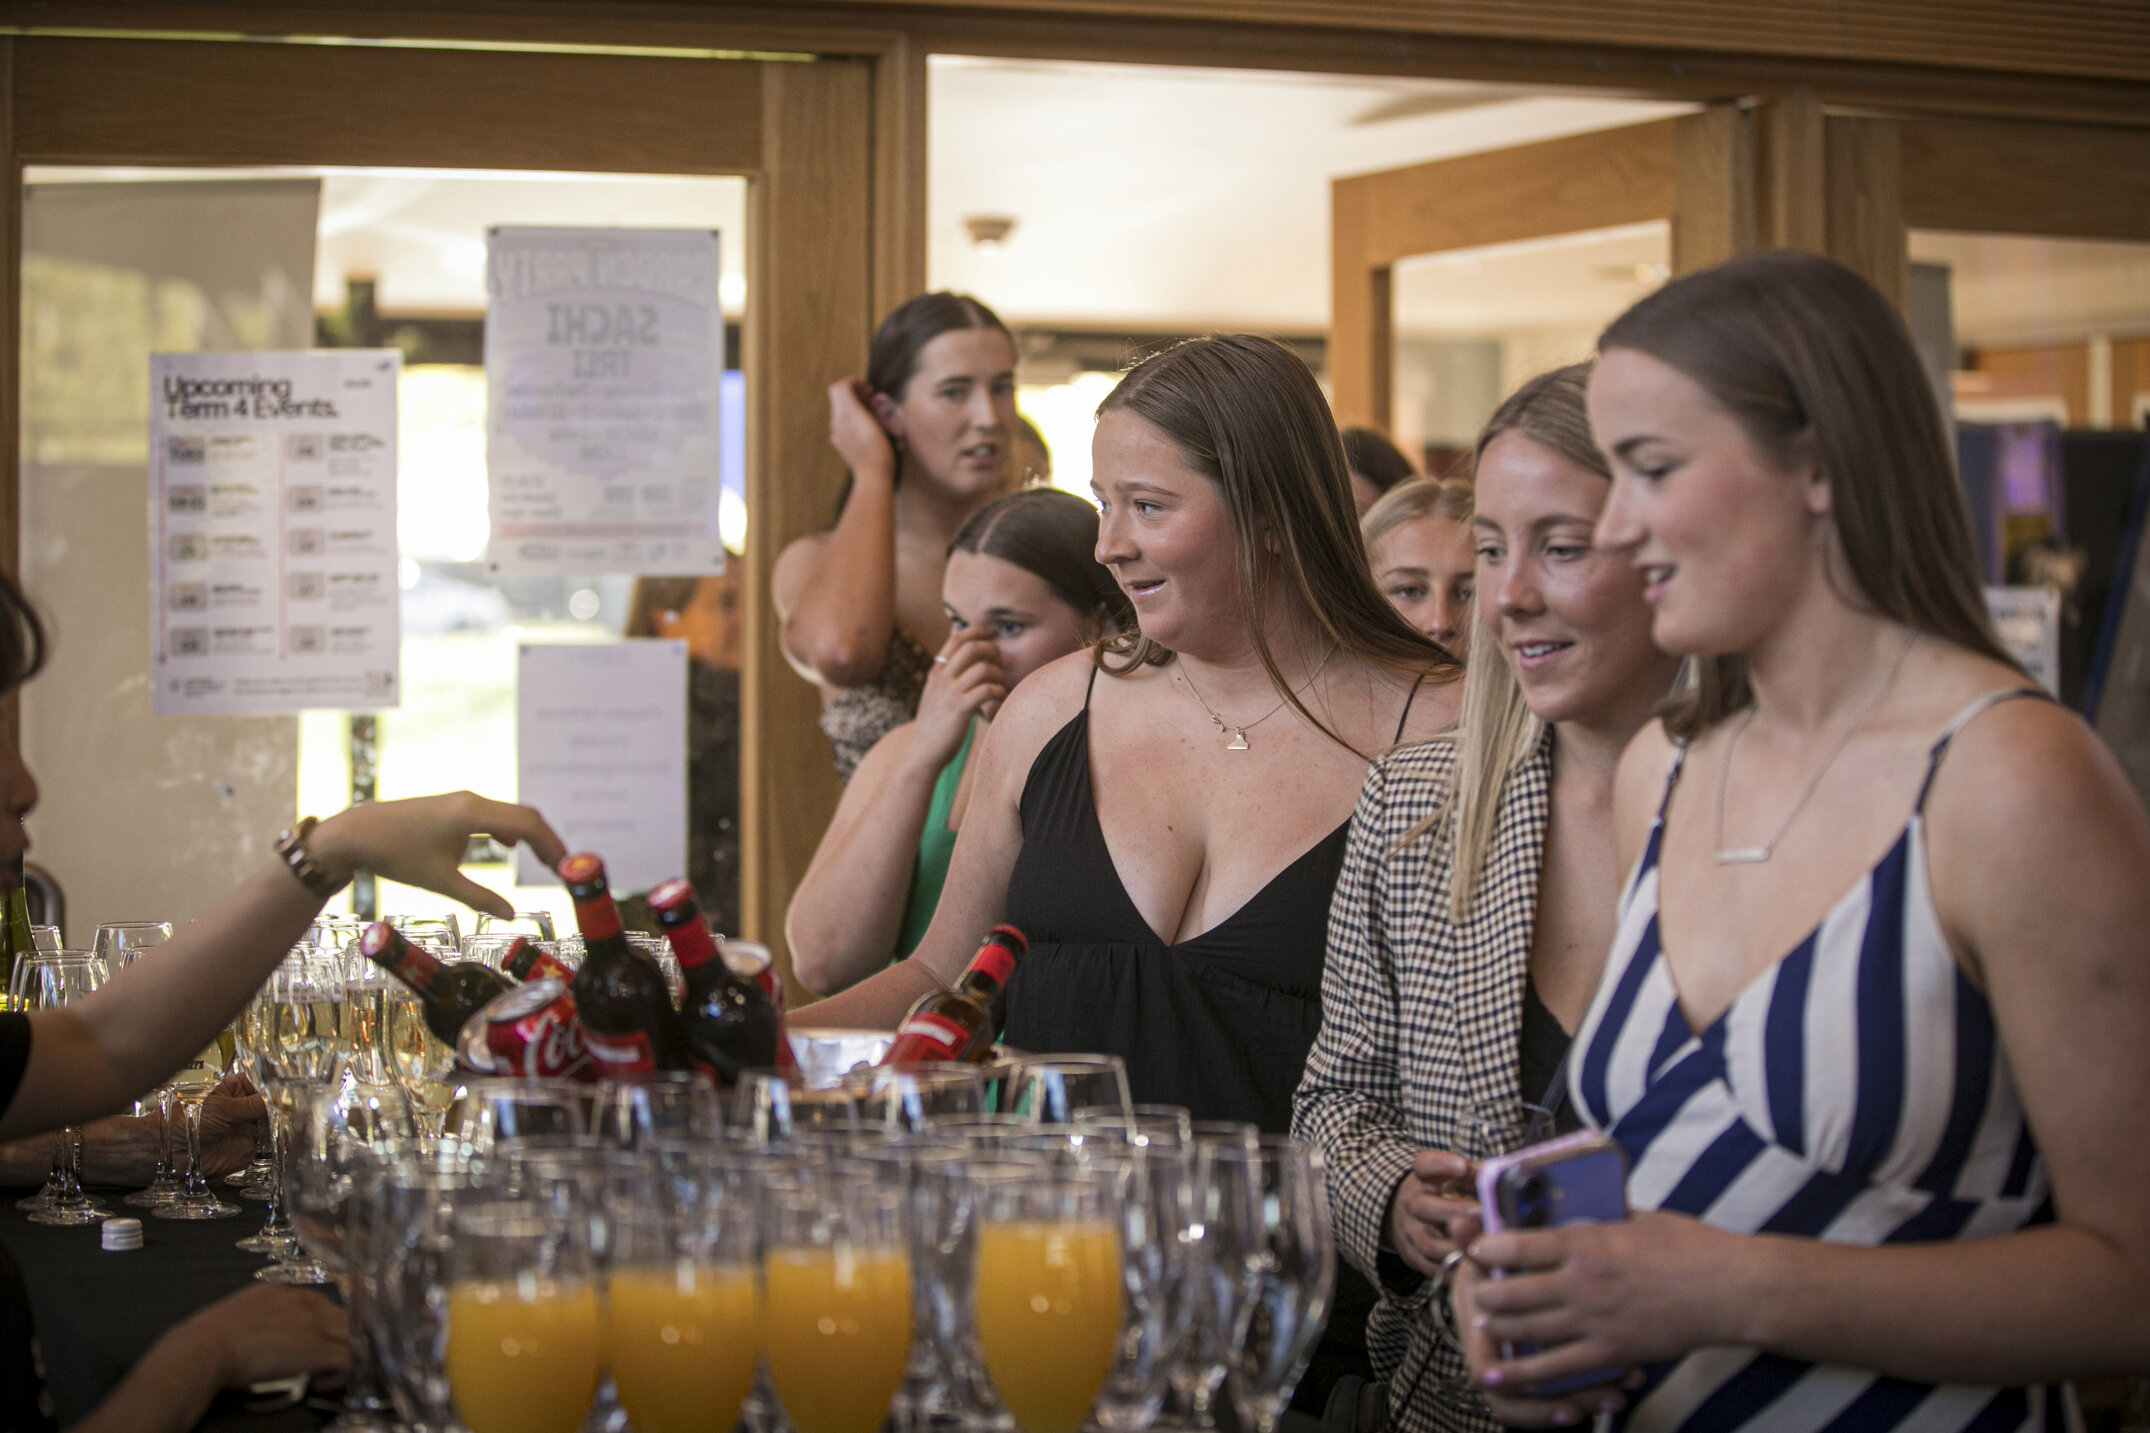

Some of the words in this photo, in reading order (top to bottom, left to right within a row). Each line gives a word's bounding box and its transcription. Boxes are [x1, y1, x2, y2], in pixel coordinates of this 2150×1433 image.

[163, 374, 292, 402] Upcoming
[165, 398, 228, 419] Term
[233, 399, 248, 416] 4
